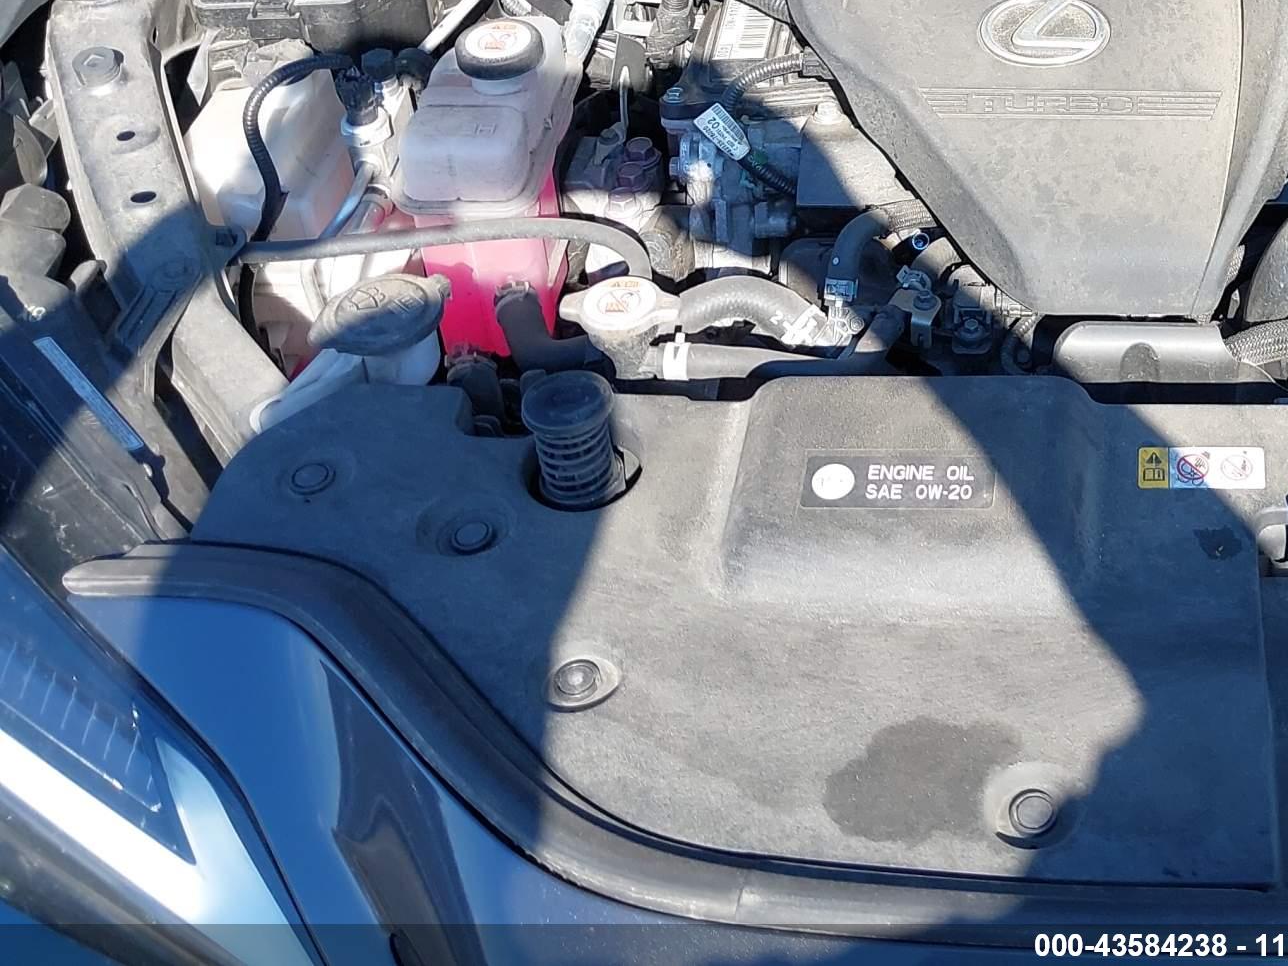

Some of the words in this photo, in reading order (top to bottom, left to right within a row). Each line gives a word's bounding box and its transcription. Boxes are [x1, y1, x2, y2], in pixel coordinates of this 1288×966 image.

[972, 92, 1135, 114] TURBO
[867, 464, 935, 481] ENGINE
[946, 465, 975, 481] OIL
[865, 483, 904, 500] SAE
[915, 484, 973, 500] 0W-20
